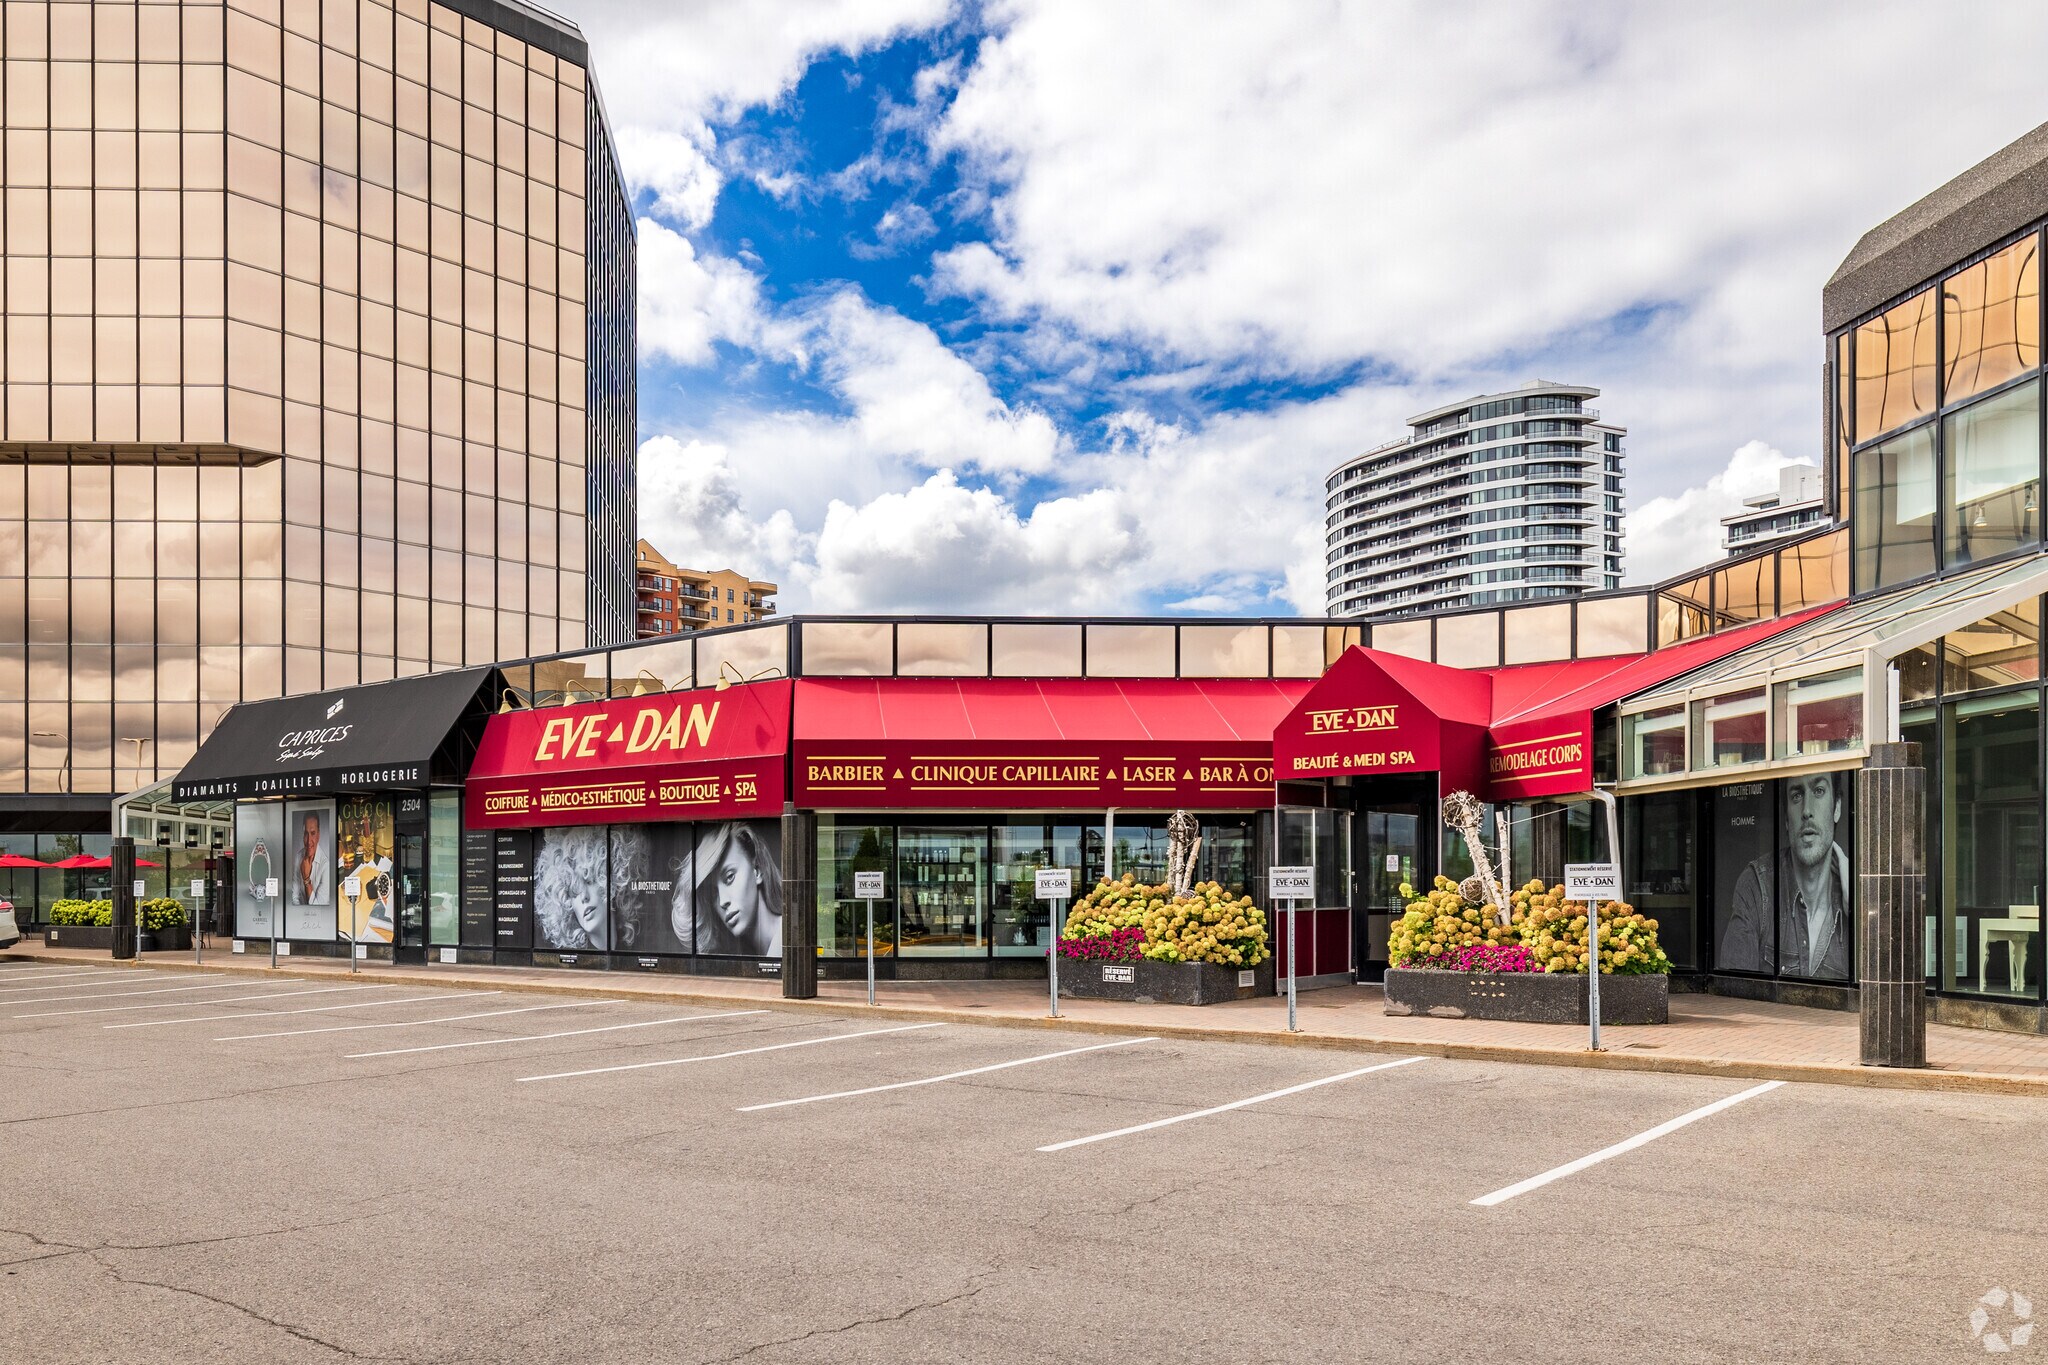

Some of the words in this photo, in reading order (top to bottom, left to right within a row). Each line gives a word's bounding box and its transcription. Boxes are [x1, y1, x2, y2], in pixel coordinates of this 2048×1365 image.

[1312, 712, 1344, 731] EVE
[1356, 708, 1395, 728] DAN
[278, 724, 354, 748] CAPRICES
[534, 713, 609, 762] EVE
[625, 701, 721, 754] DAN
[1293, 752, 1339, 770] BEAUTÉ
[1342, 755, 1352, 768] &
[1353, 752, 1386, 767] MEDI
[1389, 750, 1416, 765] SPA
[1489, 748, 1548, 773] REMODELAGE
[1549, 743, 1582, 765] CORPS
[179, 782, 238, 798] DIAMANTS
[254, 775, 322, 792] JOAILLIER
[341, 768, 419, 785] HORLOGERIE
[807, 765, 885, 781] BARBIER
[911, 765, 998, 785] CLINIQUE
[1002, 765, 1100, 782] CAPILLAIRE
[1123, 766, 1177, 783] LASER
[1200, 766, 1233, 783] BAR
[1236, 762, 1250, 783] À
[401, 798, 421, 812] 2504
[485, 795, 530, 811] COIFFURE
[659, 783, 720, 802] BOUTIQUE
[735, 781, 758, 796] SPA
[342, 801, 391, 819] GUCCI
[1731, 815, 1755, 826] HOMME
[631, 881, 638, 891] LA
[1040, 880, 1051, 888] EVE
[1573, 877, 1589, 886] EVE
[1595, 877, 1614, 886] DAN
